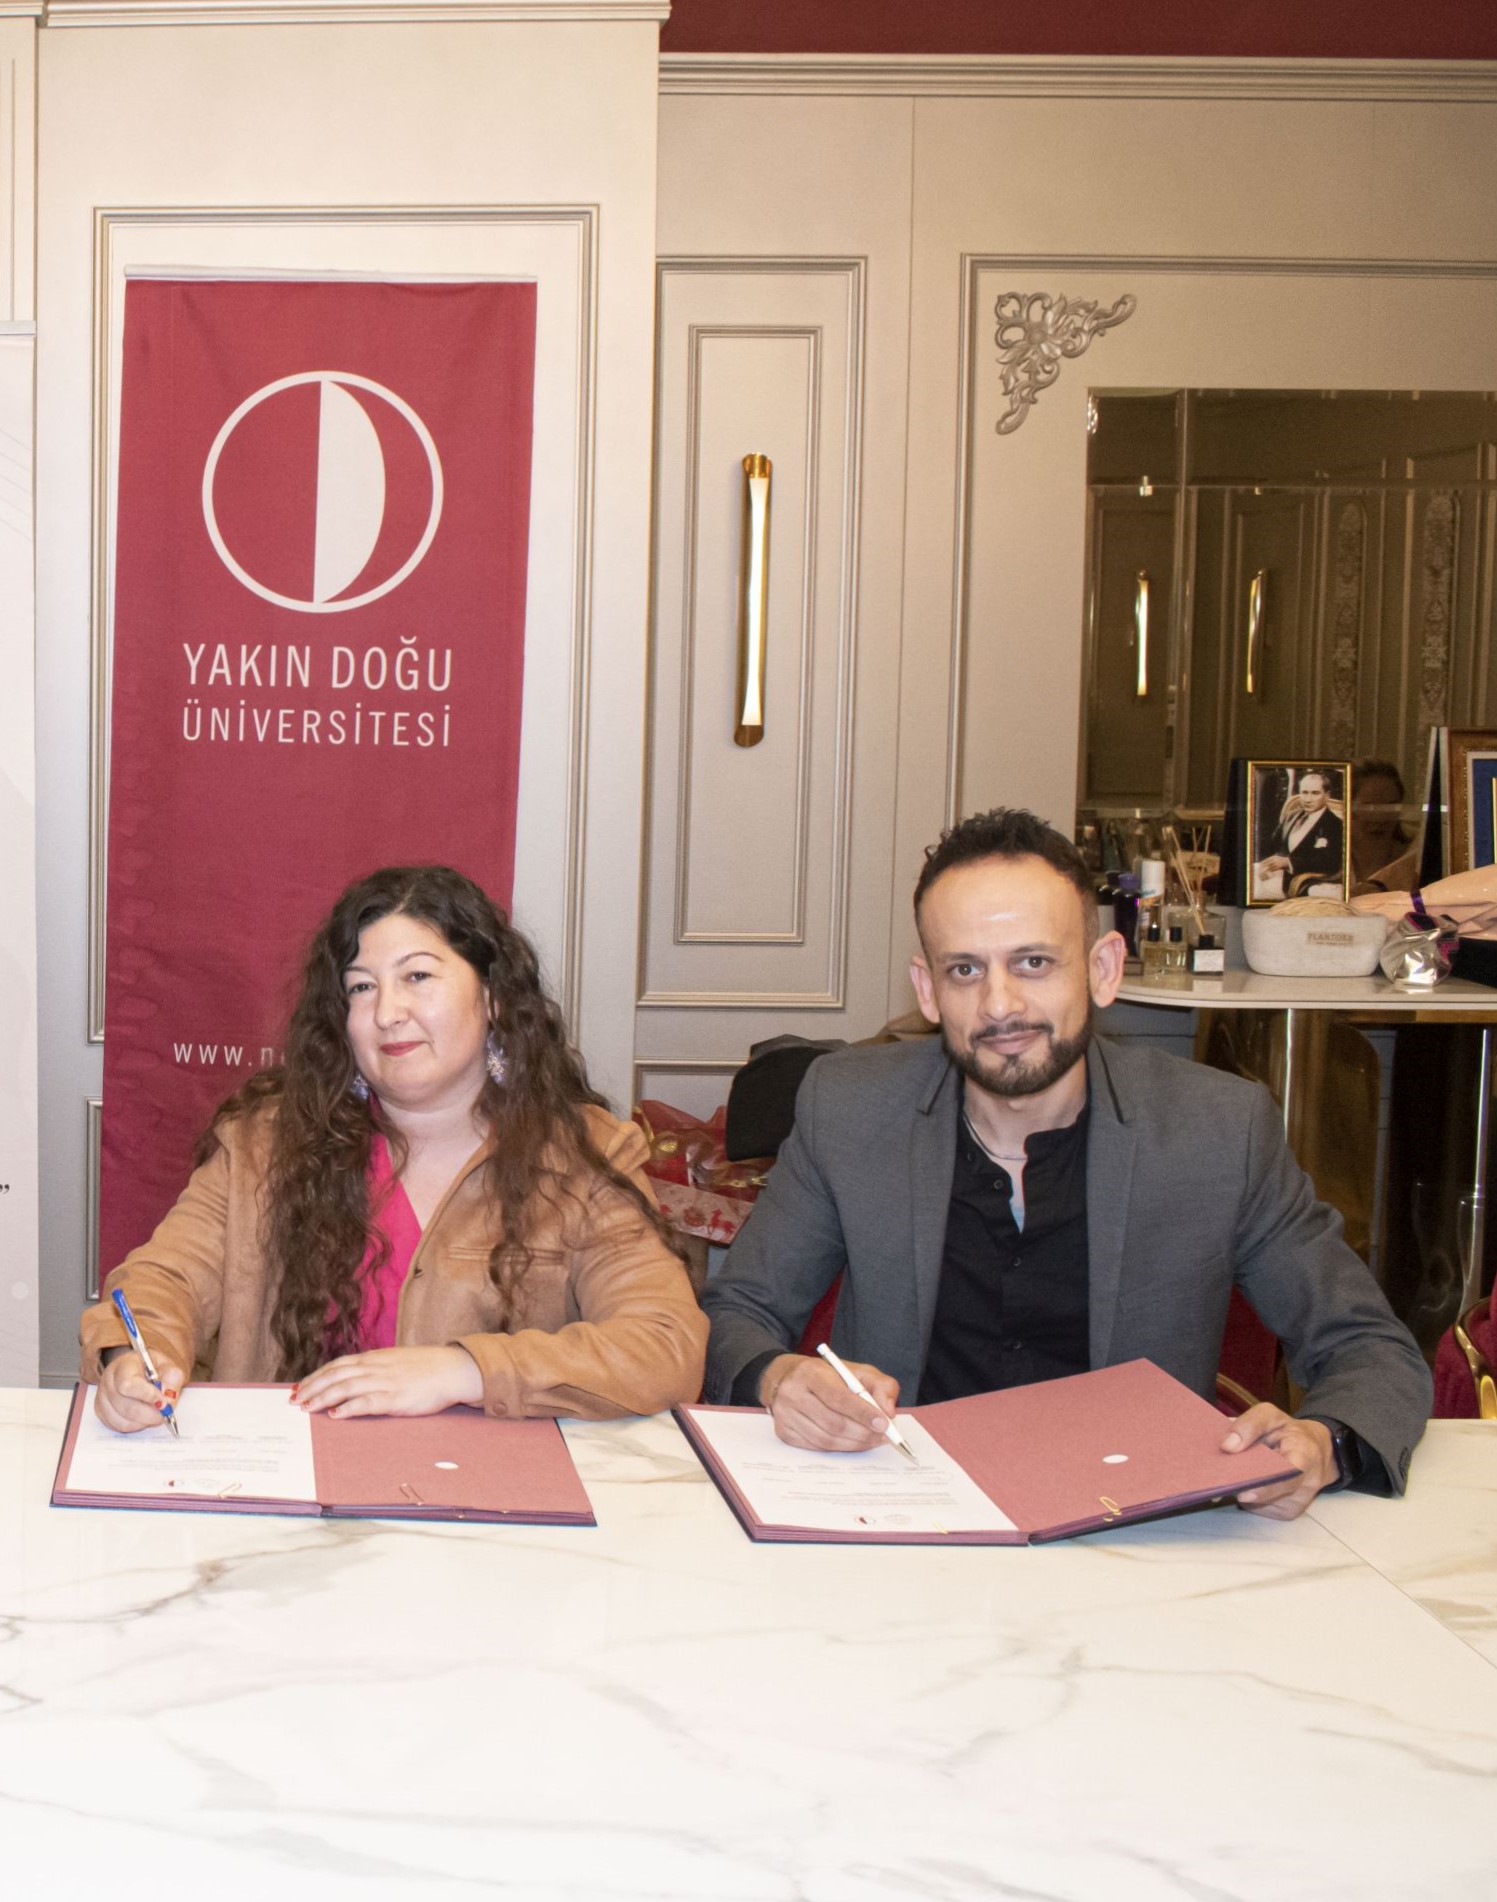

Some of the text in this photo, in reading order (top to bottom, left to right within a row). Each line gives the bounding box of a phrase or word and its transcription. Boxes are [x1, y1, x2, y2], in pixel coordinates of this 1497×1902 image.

[183, 635, 452, 692] YAKIN DOĞU
[182, 698, 452, 748] ÜNİVERSİTESİ
[173, 1042, 285, 1068] www.n
